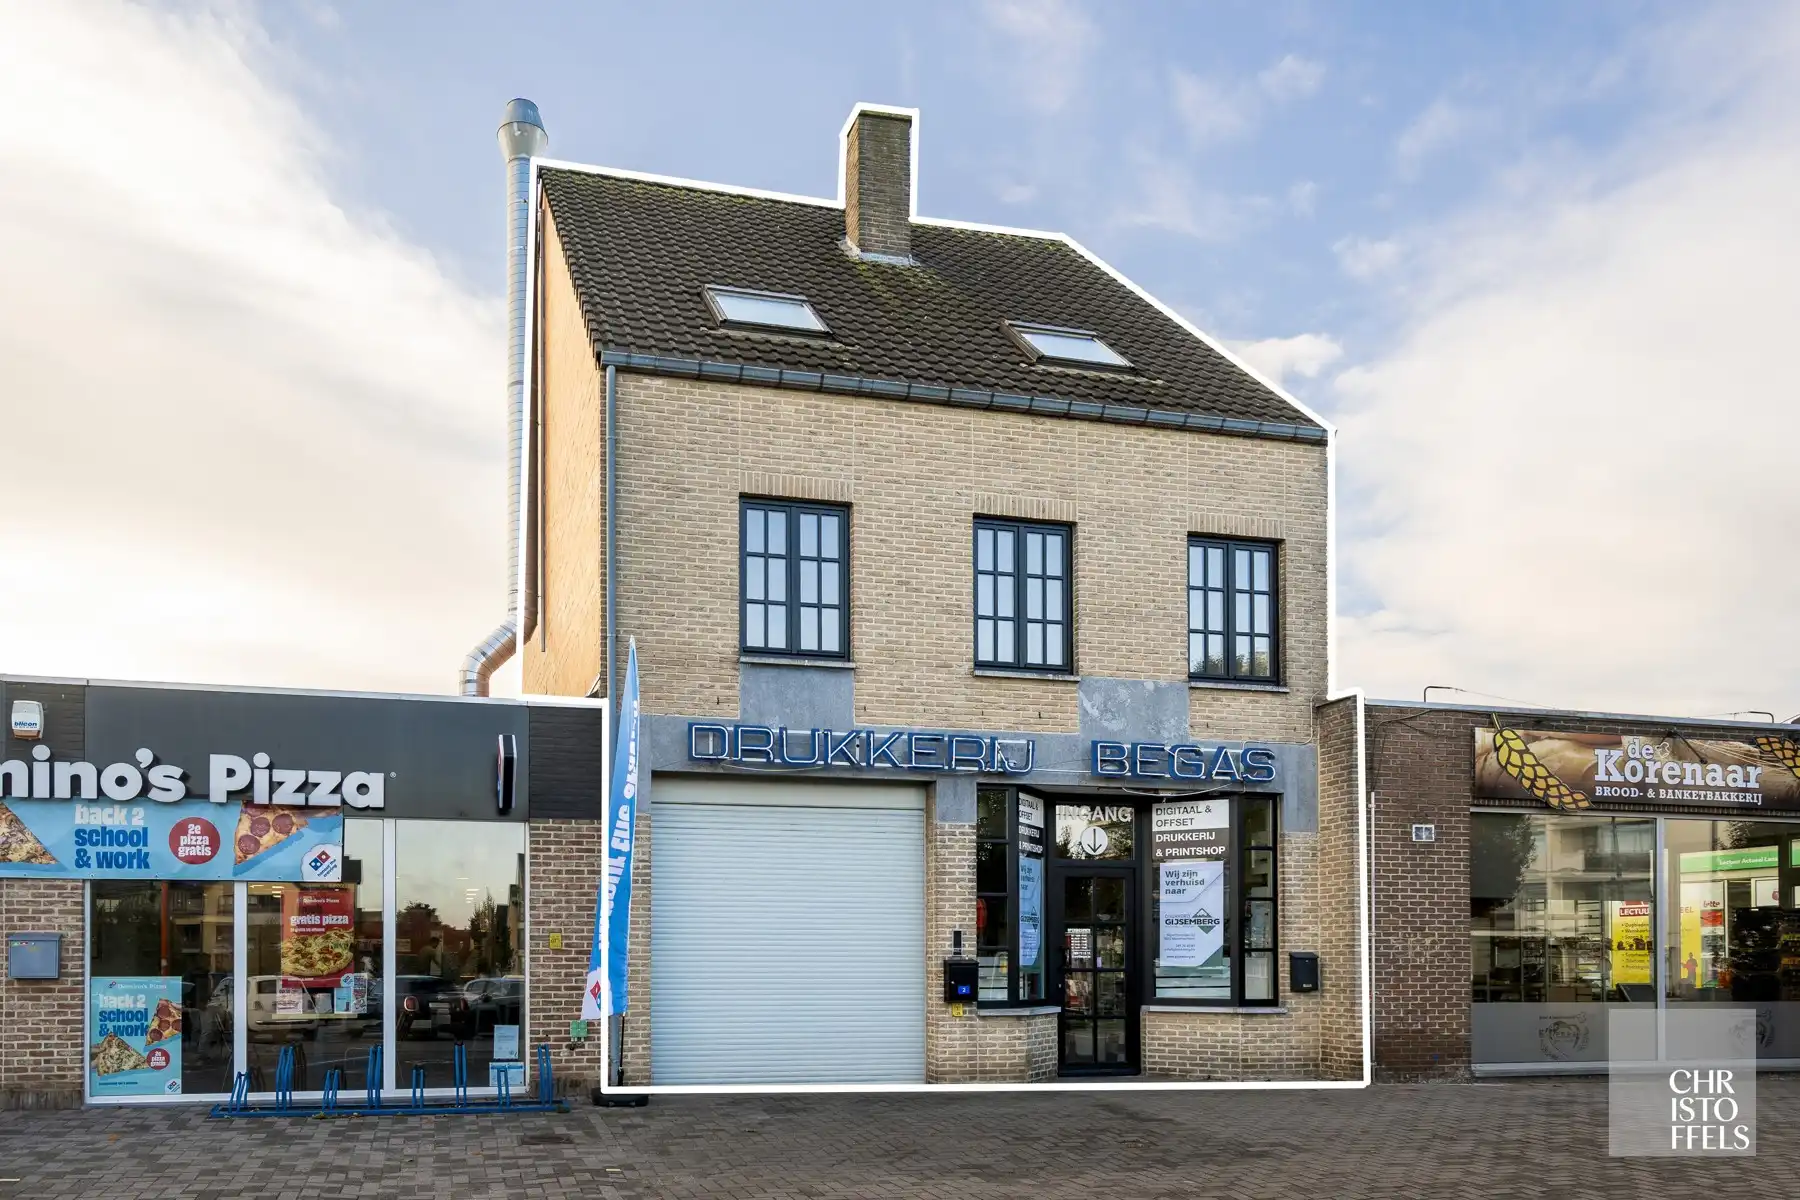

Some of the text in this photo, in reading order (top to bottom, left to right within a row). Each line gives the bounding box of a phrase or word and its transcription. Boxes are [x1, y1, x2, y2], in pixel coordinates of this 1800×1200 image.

[688, 722, 1036, 777] DRUKKERIJ
[1091, 739, 1277, 783] BEGAS
[1627, 738, 1655, 759] de
[1594, 749, 1763, 789] Korenaar
[209, 752, 385, 809] Pizza
[1595, 786, 1763, 805] BROOD- & BANKETBAKKERIJ
[75, 804, 145, 825] back 2
[1058, 805, 1132, 822] INGANG
[1155, 805, 1212, 816] DIGITAAL &
[188, 823, 201, 835] 2e
[1155, 818, 1195, 828] OFFSET
[75, 825, 148, 847] school
[180, 833, 209, 846] pizza
[1155, 831, 1215, 843] DRUKKERIJ
[178, 845, 212, 857] gratis
[1155, 846, 1226, 857] & PRINTSHOP
[75, 848, 150, 869] & work
[1165, 869, 1198, 879] Wij zijn
[290, 914, 349, 926] gratis pizza
[99, 993, 146, 1008] back 2
[99, 1008, 148, 1022] school
[99, 1023, 148, 1037] & work
